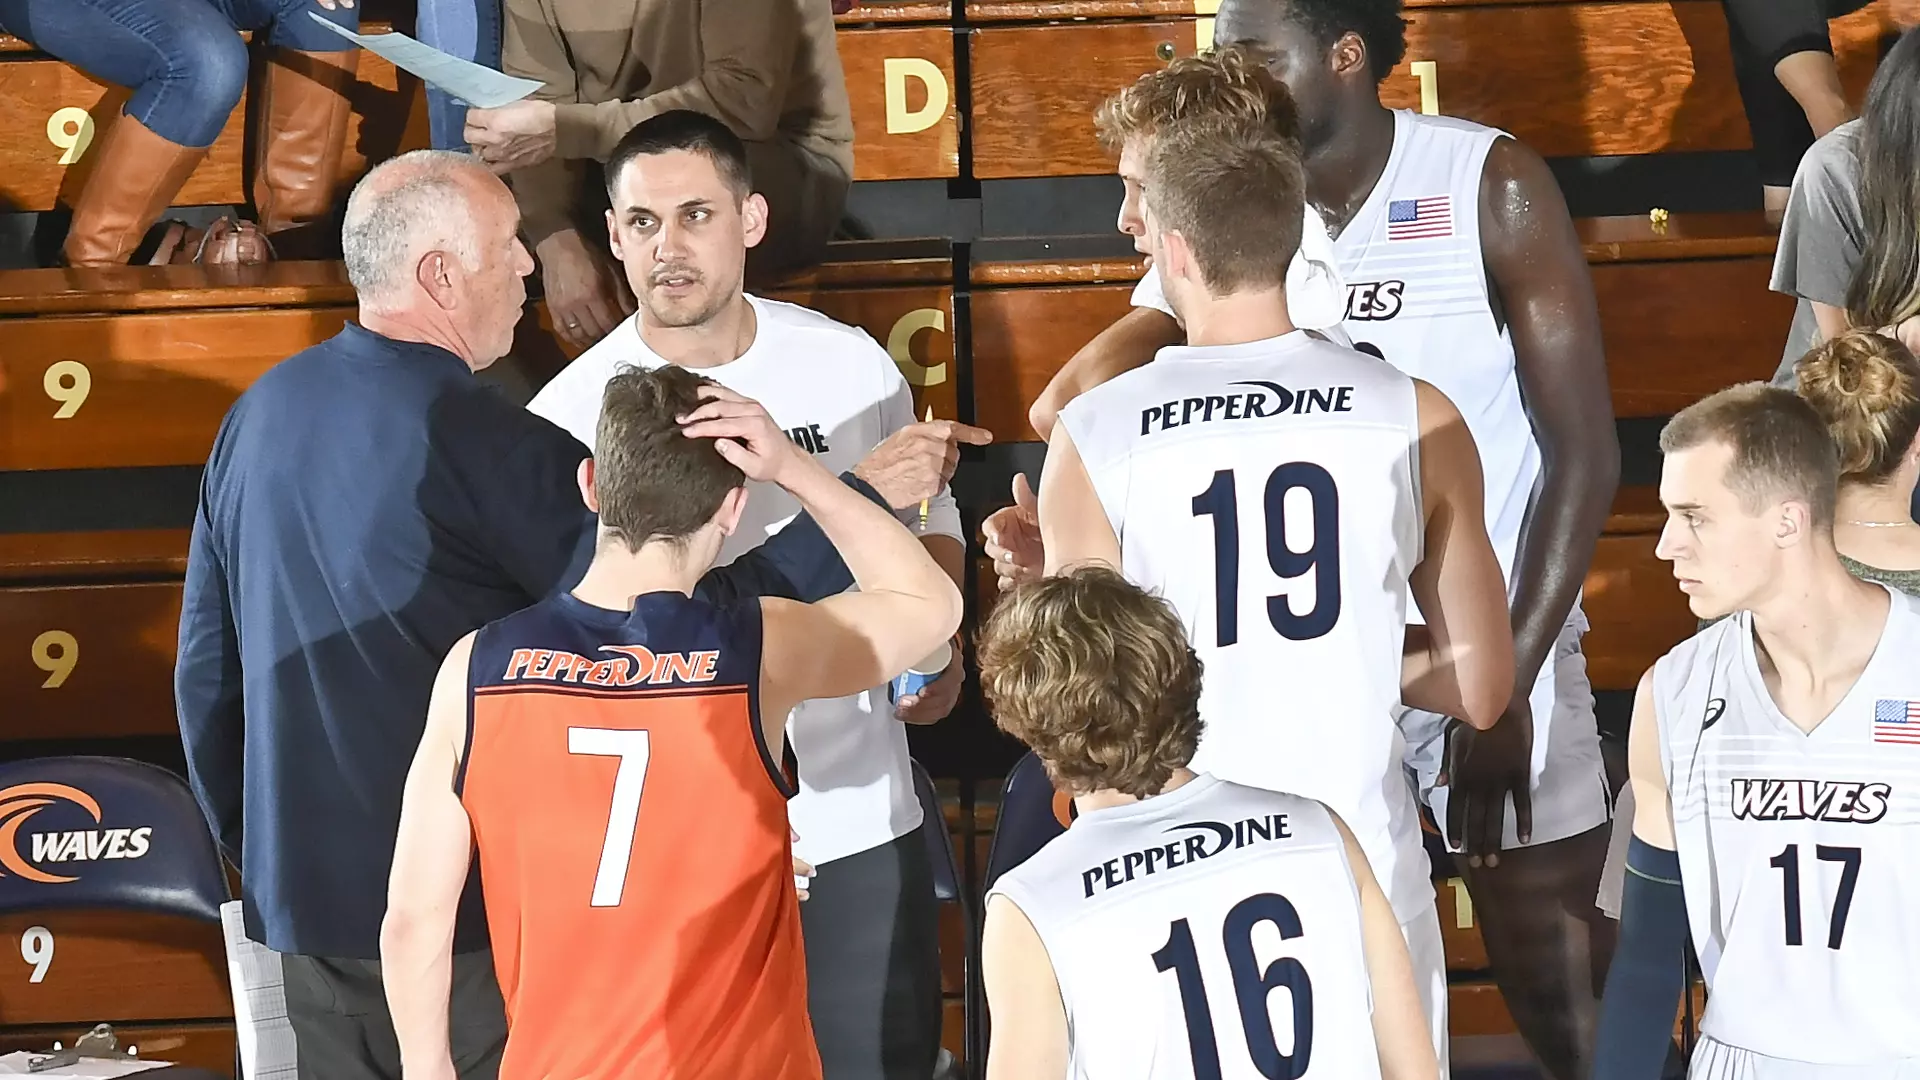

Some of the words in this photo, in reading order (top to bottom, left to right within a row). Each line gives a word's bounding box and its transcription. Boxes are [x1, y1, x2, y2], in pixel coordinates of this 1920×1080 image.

[884, 58, 949, 134] D
[1411, 61, 1440, 116] 1
[47, 107, 95, 165] 9
[887, 308, 947, 386] C
[44, 361, 91, 418] 9
[1142, 381, 1353, 436] PEPPERDINE
[1192, 461, 1342, 648] 19
[31, 630, 79, 688] 9
[503, 645, 720, 687] PEPPERDINE
[568, 726, 650, 908] 7
[1731, 778, 1892, 824] WAVES
[31, 826, 152, 863] WAVES
[1082, 813, 1292, 899] PEPPERDINE
[1769, 844, 1862, 950] 17
[20, 926, 55, 984] 9
[1151, 892, 1314, 1080] 16
